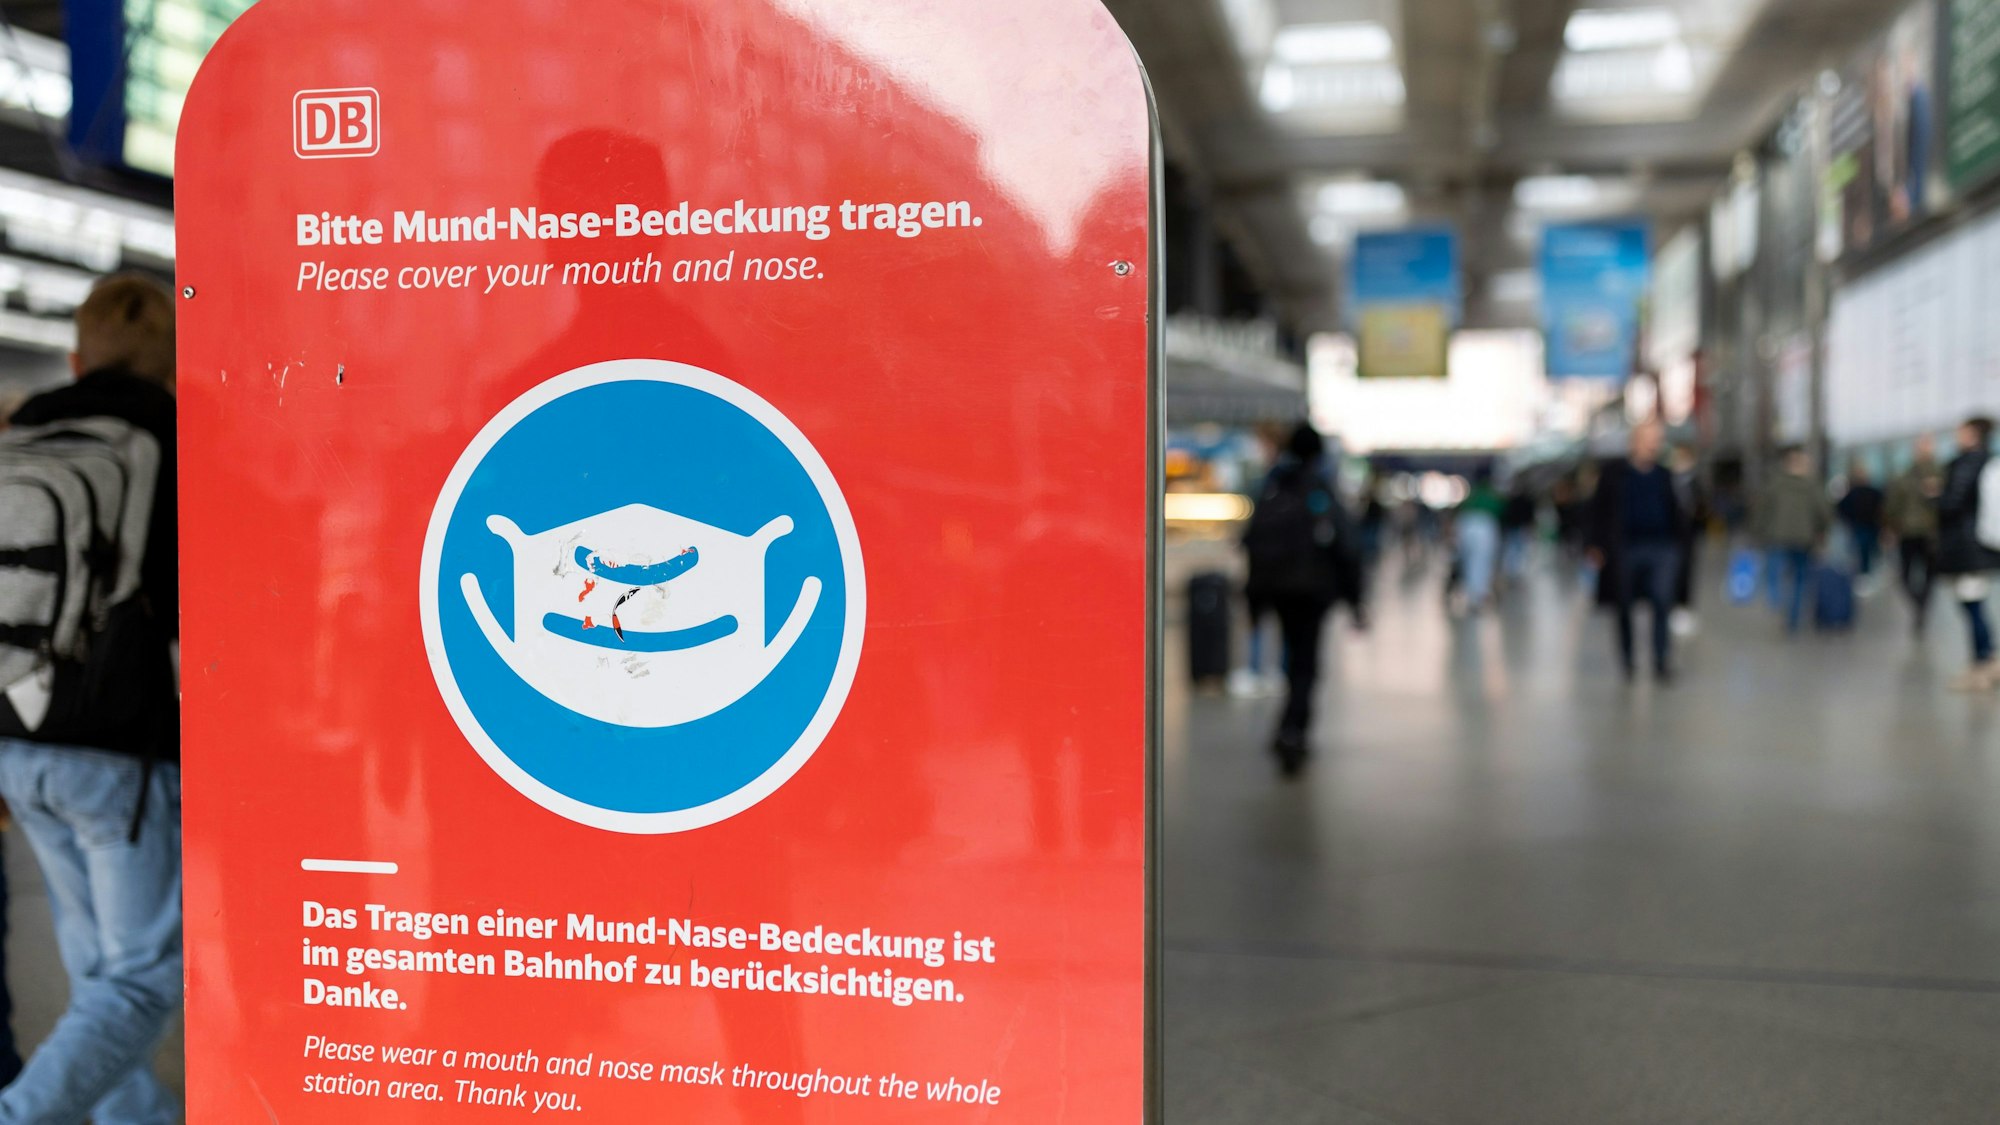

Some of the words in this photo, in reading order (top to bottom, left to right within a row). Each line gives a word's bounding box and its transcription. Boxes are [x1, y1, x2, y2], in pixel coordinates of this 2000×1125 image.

[306, 101, 368, 146] DB
[296, 211, 384, 246] Bitte
[393, 198, 831, 243] Mund-Nase-Bedeckung
[838, 199, 983, 238] tragen.
[297, 260, 389, 291] Please
[397, 265, 478, 289] cover
[484, 263, 554, 294] your
[561, 252, 662, 285] mouth
[672, 250, 735, 283] and
[743, 256, 824, 281] nose.
[303, 900, 358, 930] Das
[364, 903, 469, 940] Tragen
[477, 908, 558, 939] einer
[566, 913, 945, 968] Mund-Nase-Bedeckung
[953, 930, 996, 964] ist
[302, 937, 339, 967] im
[345, 947, 495, 976] gesamten
[504, 949, 638, 983] Bahnhof
[644, 963, 681, 986] zu
[690, 958, 965, 1007] berücksichtigen.
[303, 978, 408, 1011] Danke.
[302, 1072, 381, 1097] station
[387, 1080, 444, 1102] area.
[455, 1079, 527, 1107] Thank
[532, 1091, 582, 1114] you.
[303, 1035, 375, 1062] Please
[381, 1046, 437, 1066] wear
[442, 1050, 457, 1068] a
[463, 1049, 539, 1073] mouth
[545, 1052, 593, 1077] and
[598, 1060, 654, 1081] nose
[660, 1060, 725, 1086] mask
[732, 1063, 872, 1098] throughout
[878, 1072, 919, 1100] the
[926, 1076, 1002, 1106] whole
